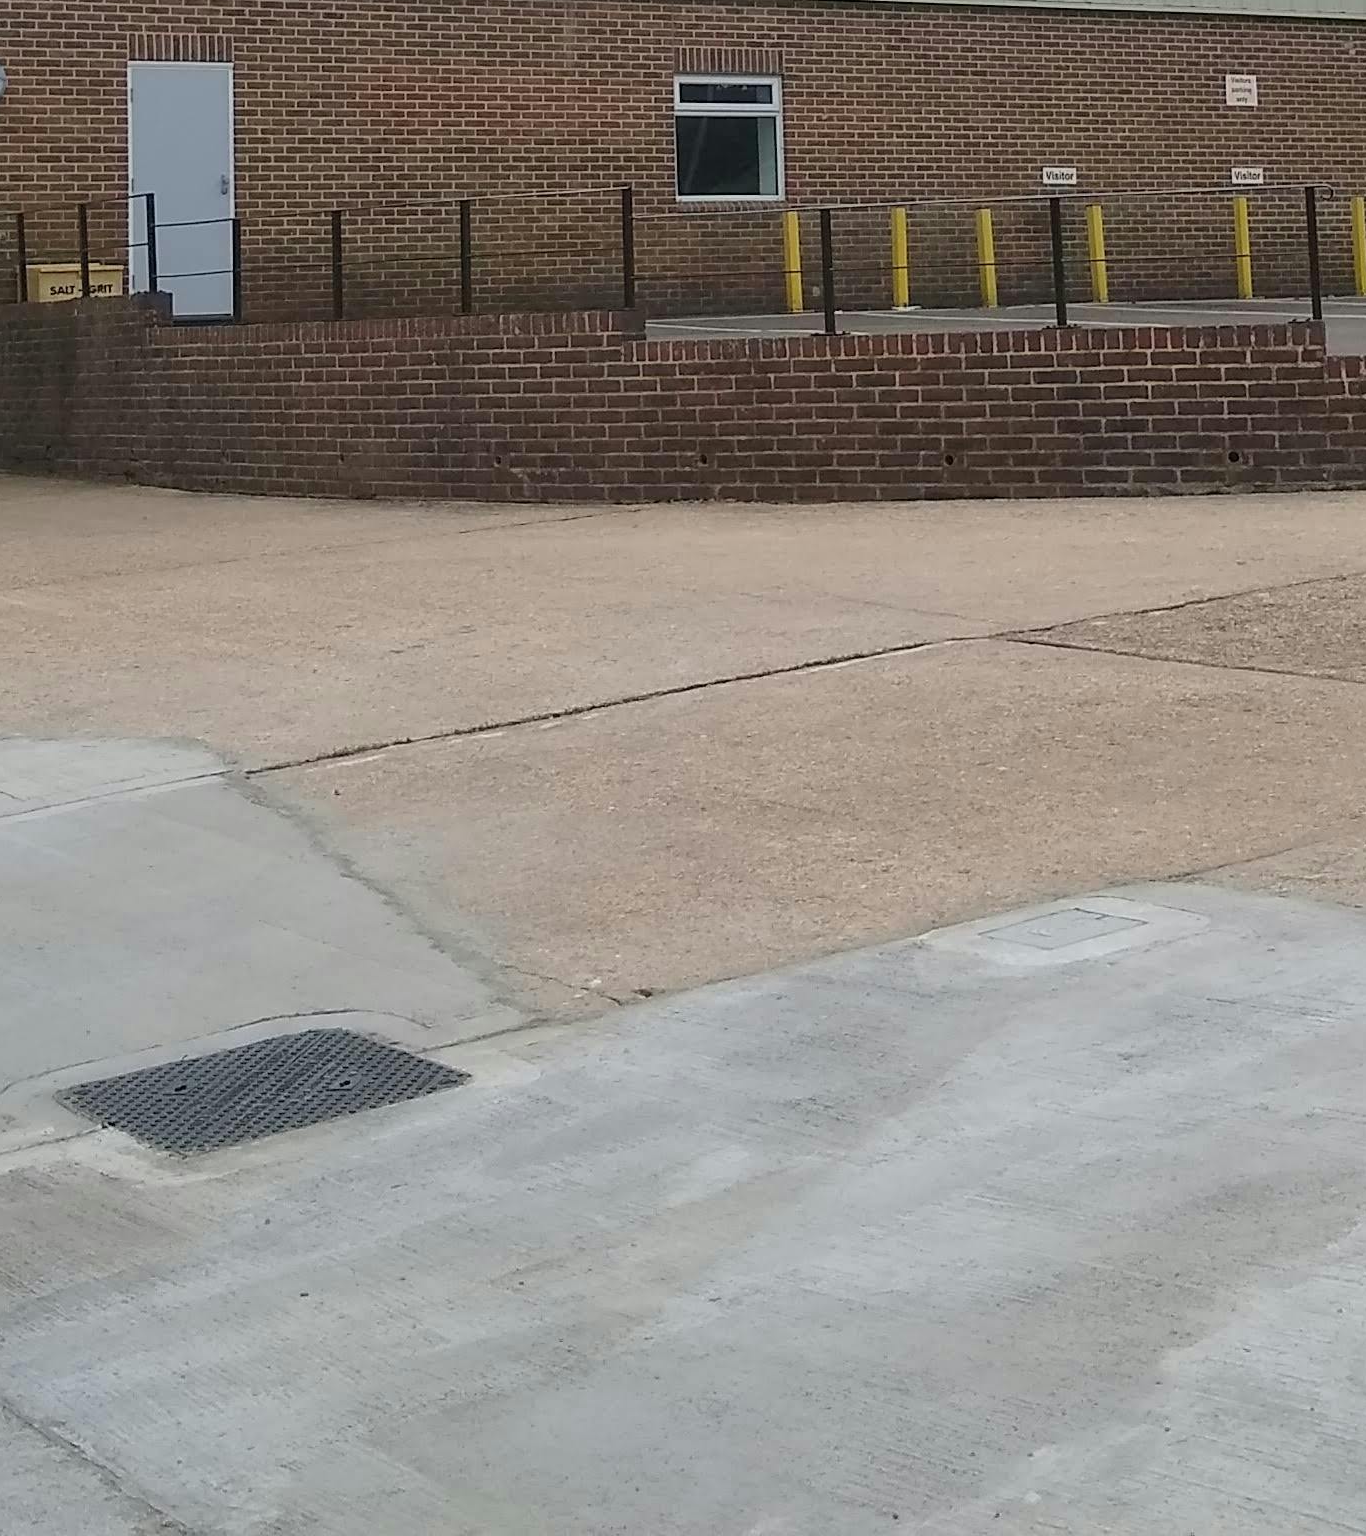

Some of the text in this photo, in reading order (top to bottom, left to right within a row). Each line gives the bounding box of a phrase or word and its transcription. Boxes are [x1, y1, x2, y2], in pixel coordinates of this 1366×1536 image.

[1046, 170, 1074, 181] Visitor
[1234, 170, 1261, 181] Visitor
[50, 285, 76, 295] SALT
[89, 284, 113, 293] GRIT
